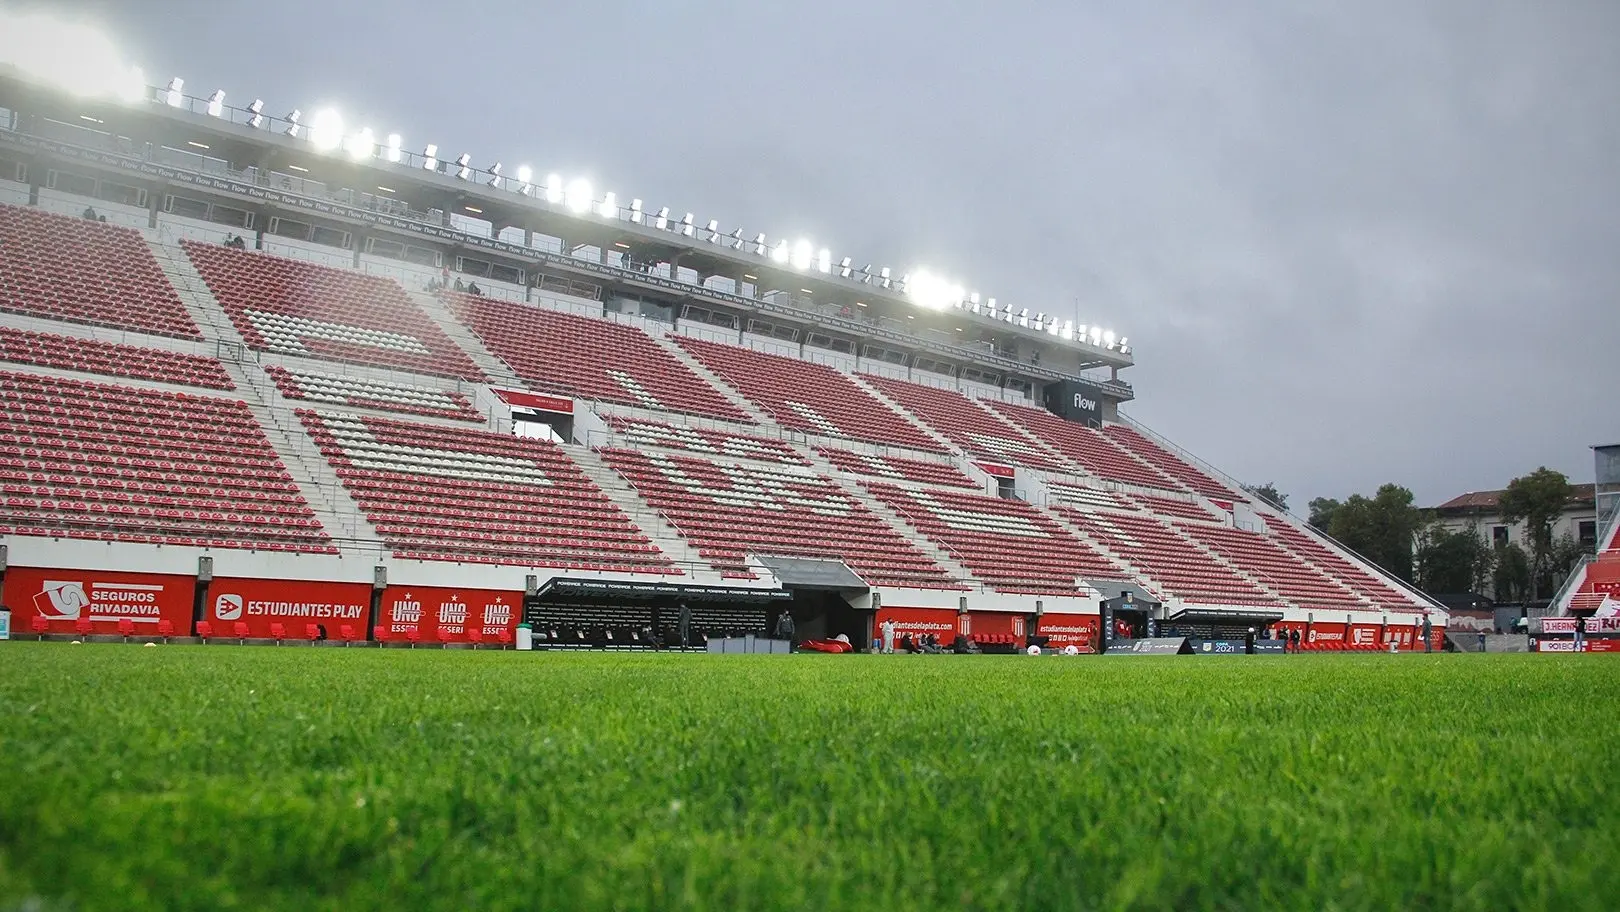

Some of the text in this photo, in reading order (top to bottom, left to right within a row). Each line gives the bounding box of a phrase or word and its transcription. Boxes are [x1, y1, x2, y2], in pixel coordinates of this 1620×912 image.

[1074, 393, 1096, 410] flow
[92, 590, 156, 602] SEGUROS
[90, 603, 160, 615] RIVADAVIA
[248, 601, 363, 618] ESTUDIANTES PLAY
[392, 600, 420, 622] UNO
[440, 602, 466, 624] UNO
[484, 604, 510, 624] UNO
[879, 621, 952, 631] esdiantesdelaplata.com
[1546, 622, 1597, 631] J.HERNEZ
